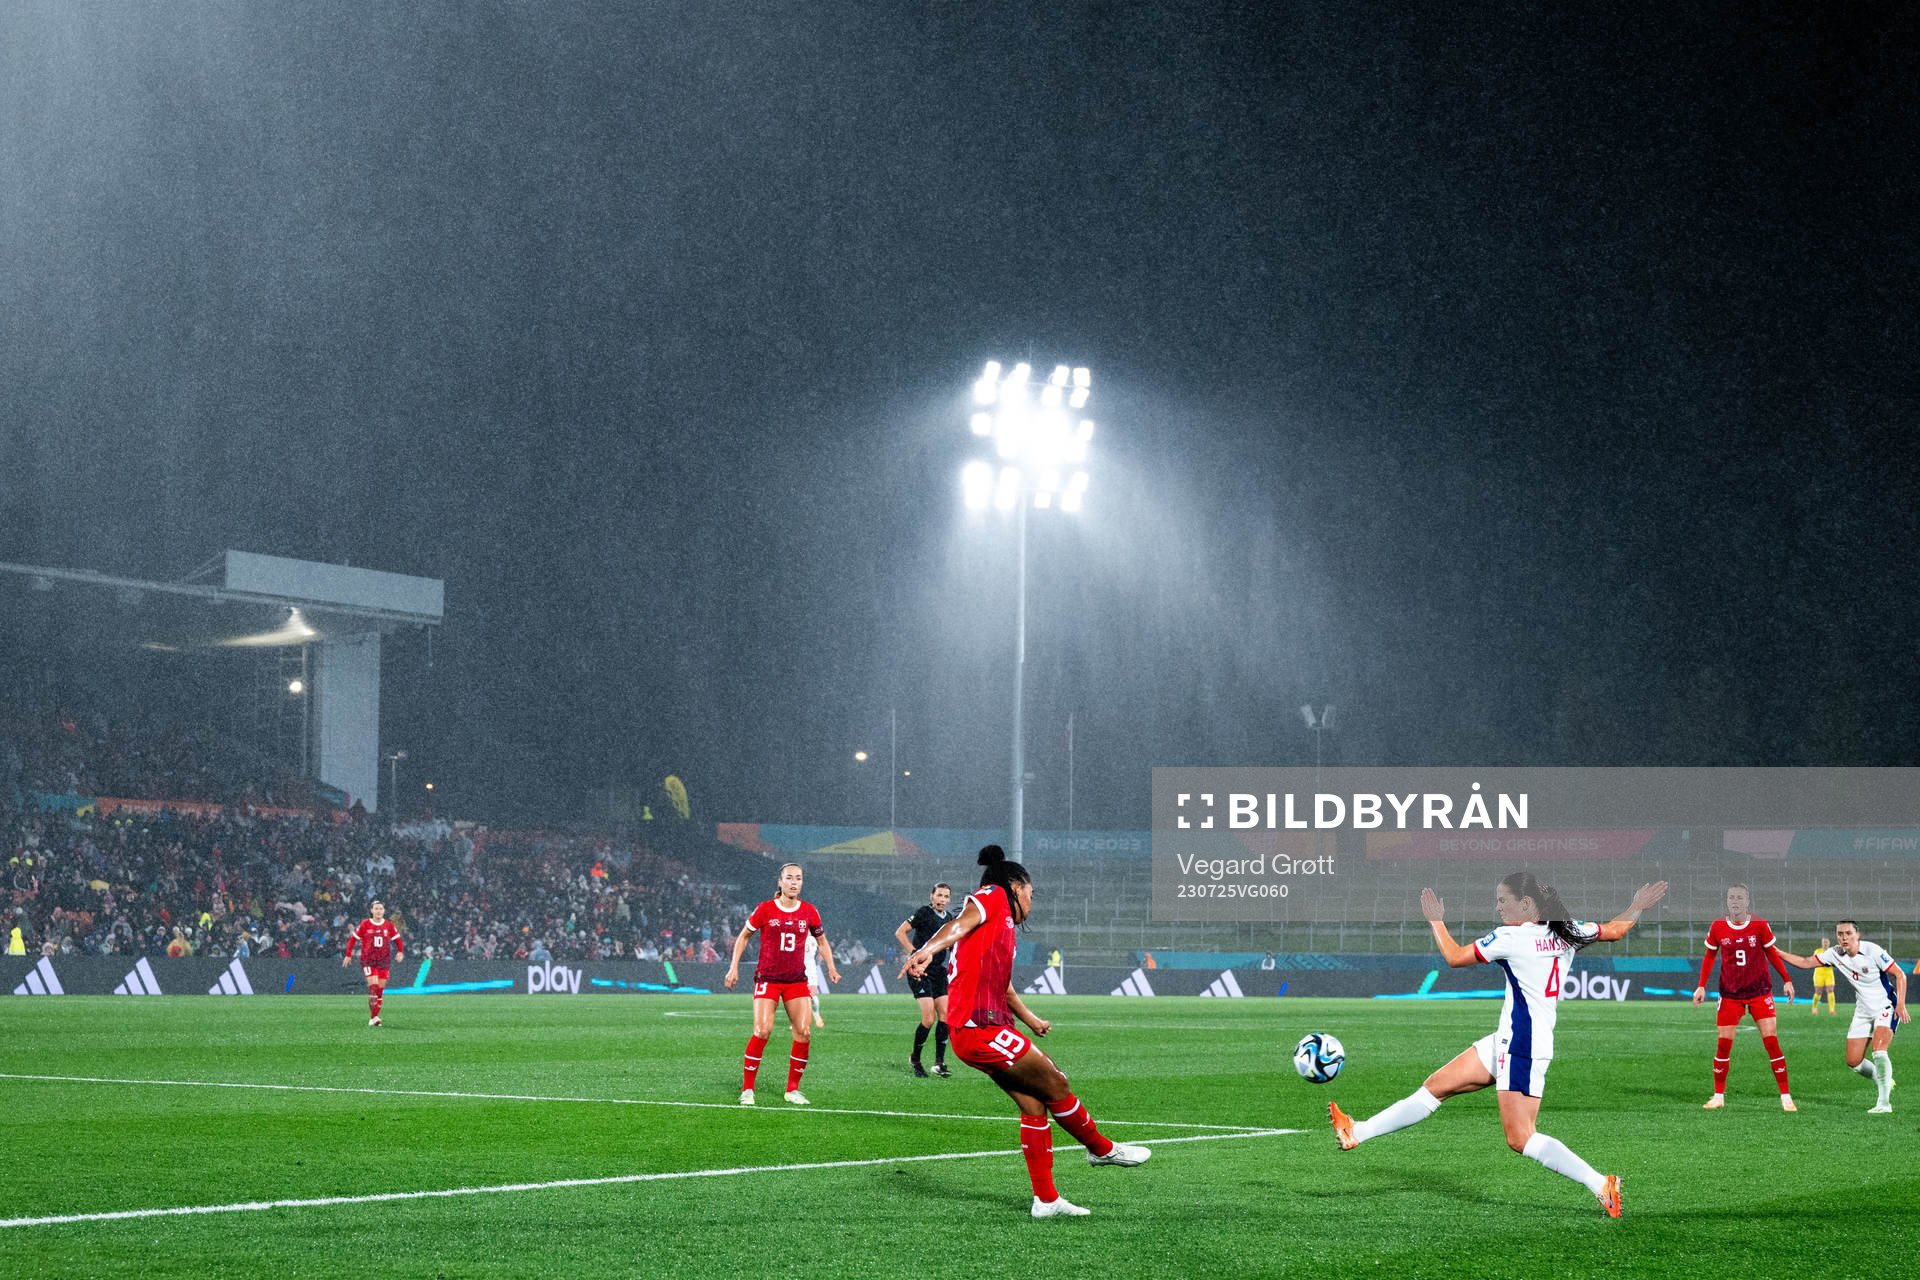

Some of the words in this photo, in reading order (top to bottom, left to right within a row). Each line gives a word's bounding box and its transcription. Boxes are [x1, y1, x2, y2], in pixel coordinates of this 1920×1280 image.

[1094, 838, 1141, 850] 2023
[1439, 838, 1500, 851] BEYOND
[1506, 838, 1599, 850] GREATNESS
[374, 936, 383, 948] 10
[780, 932, 796, 952] 13
[1735, 949, 1747, 967] 9
[527, 960, 583, 995] play
[1545, 957, 1560, 1001] 4
[988, 1028, 1025, 1060] 19
